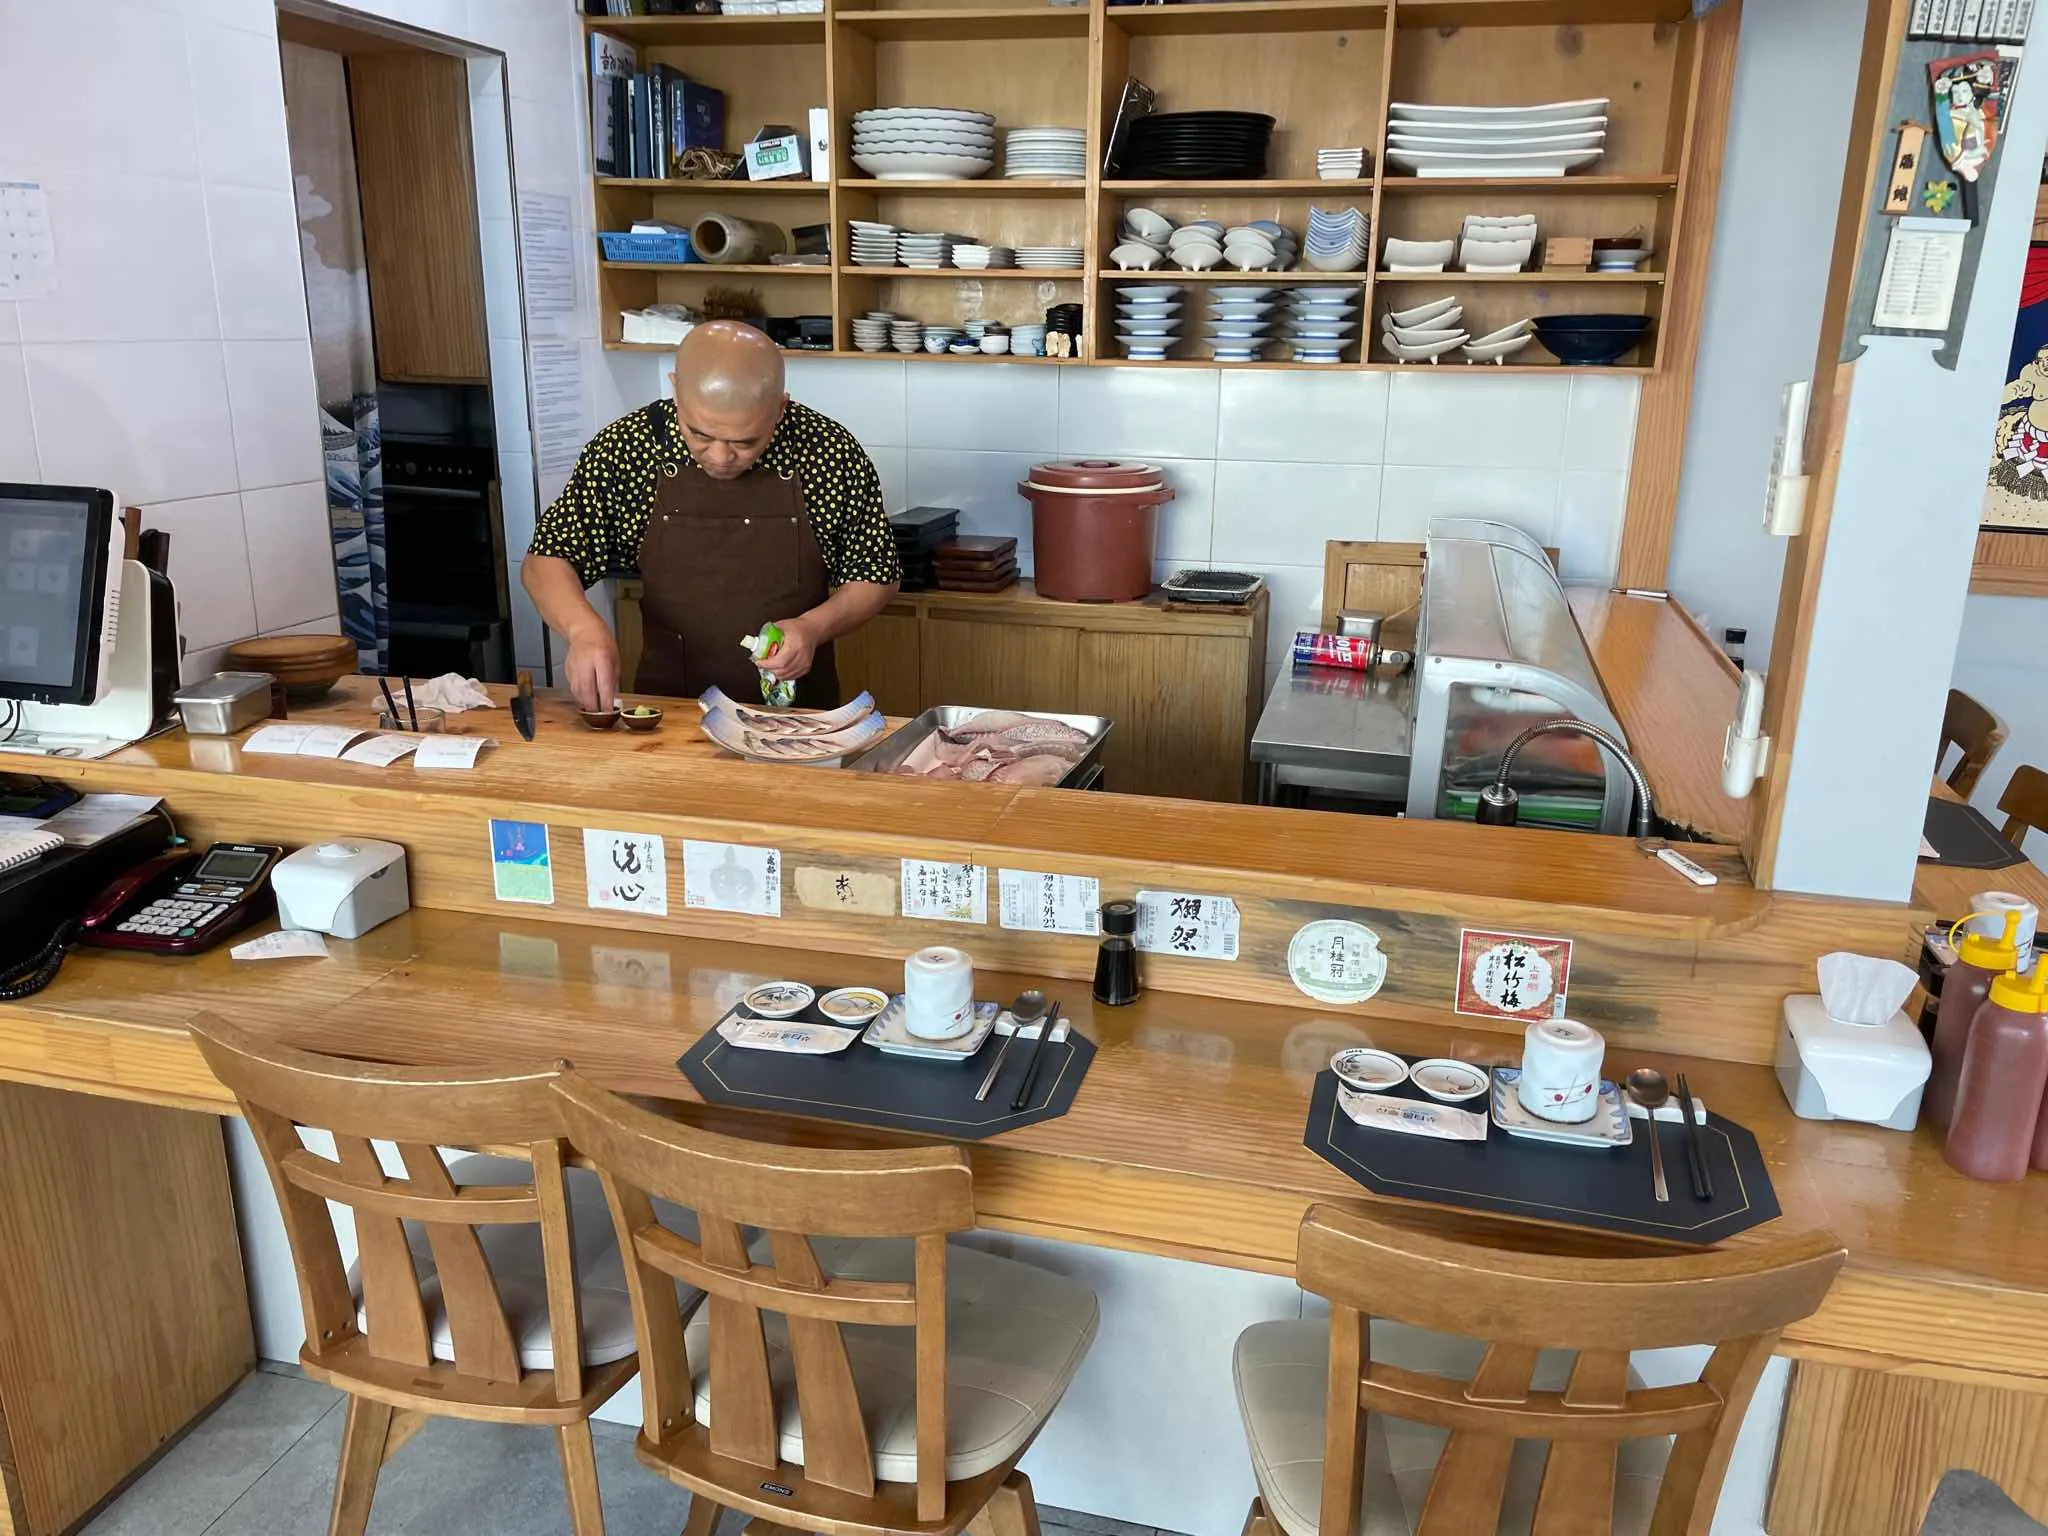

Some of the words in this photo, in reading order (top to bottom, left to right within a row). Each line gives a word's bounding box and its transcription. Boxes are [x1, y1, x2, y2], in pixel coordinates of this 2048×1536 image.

[1329, 936, 1345, 978] 月桂冠
[1500, 949, 1526, 1008] 松竹梅
